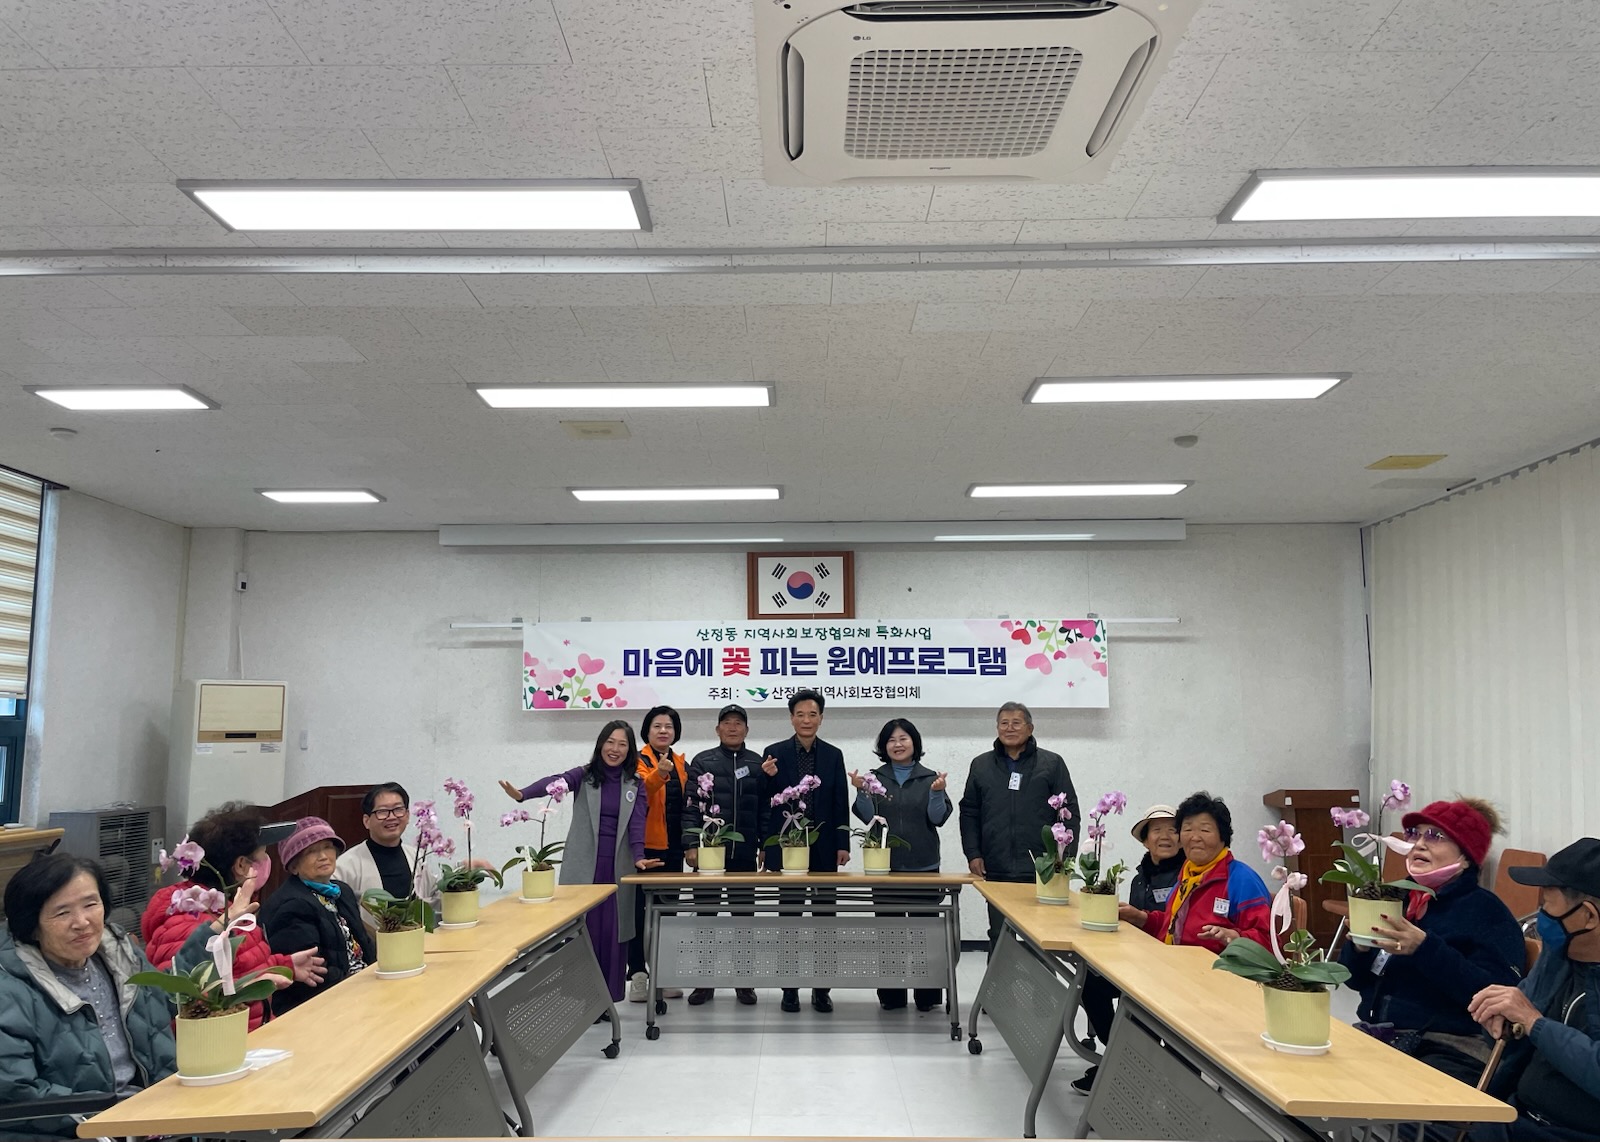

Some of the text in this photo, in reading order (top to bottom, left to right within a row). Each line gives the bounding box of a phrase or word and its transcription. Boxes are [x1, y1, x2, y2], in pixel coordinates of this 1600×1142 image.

[696, 625, 932, 642] 산정동 지역사회보장협의체 특화사업
[623, 646, 1007, 677] 마음에 꽃 피는 원예프로그램
[708, 686, 732, 701] 주최
